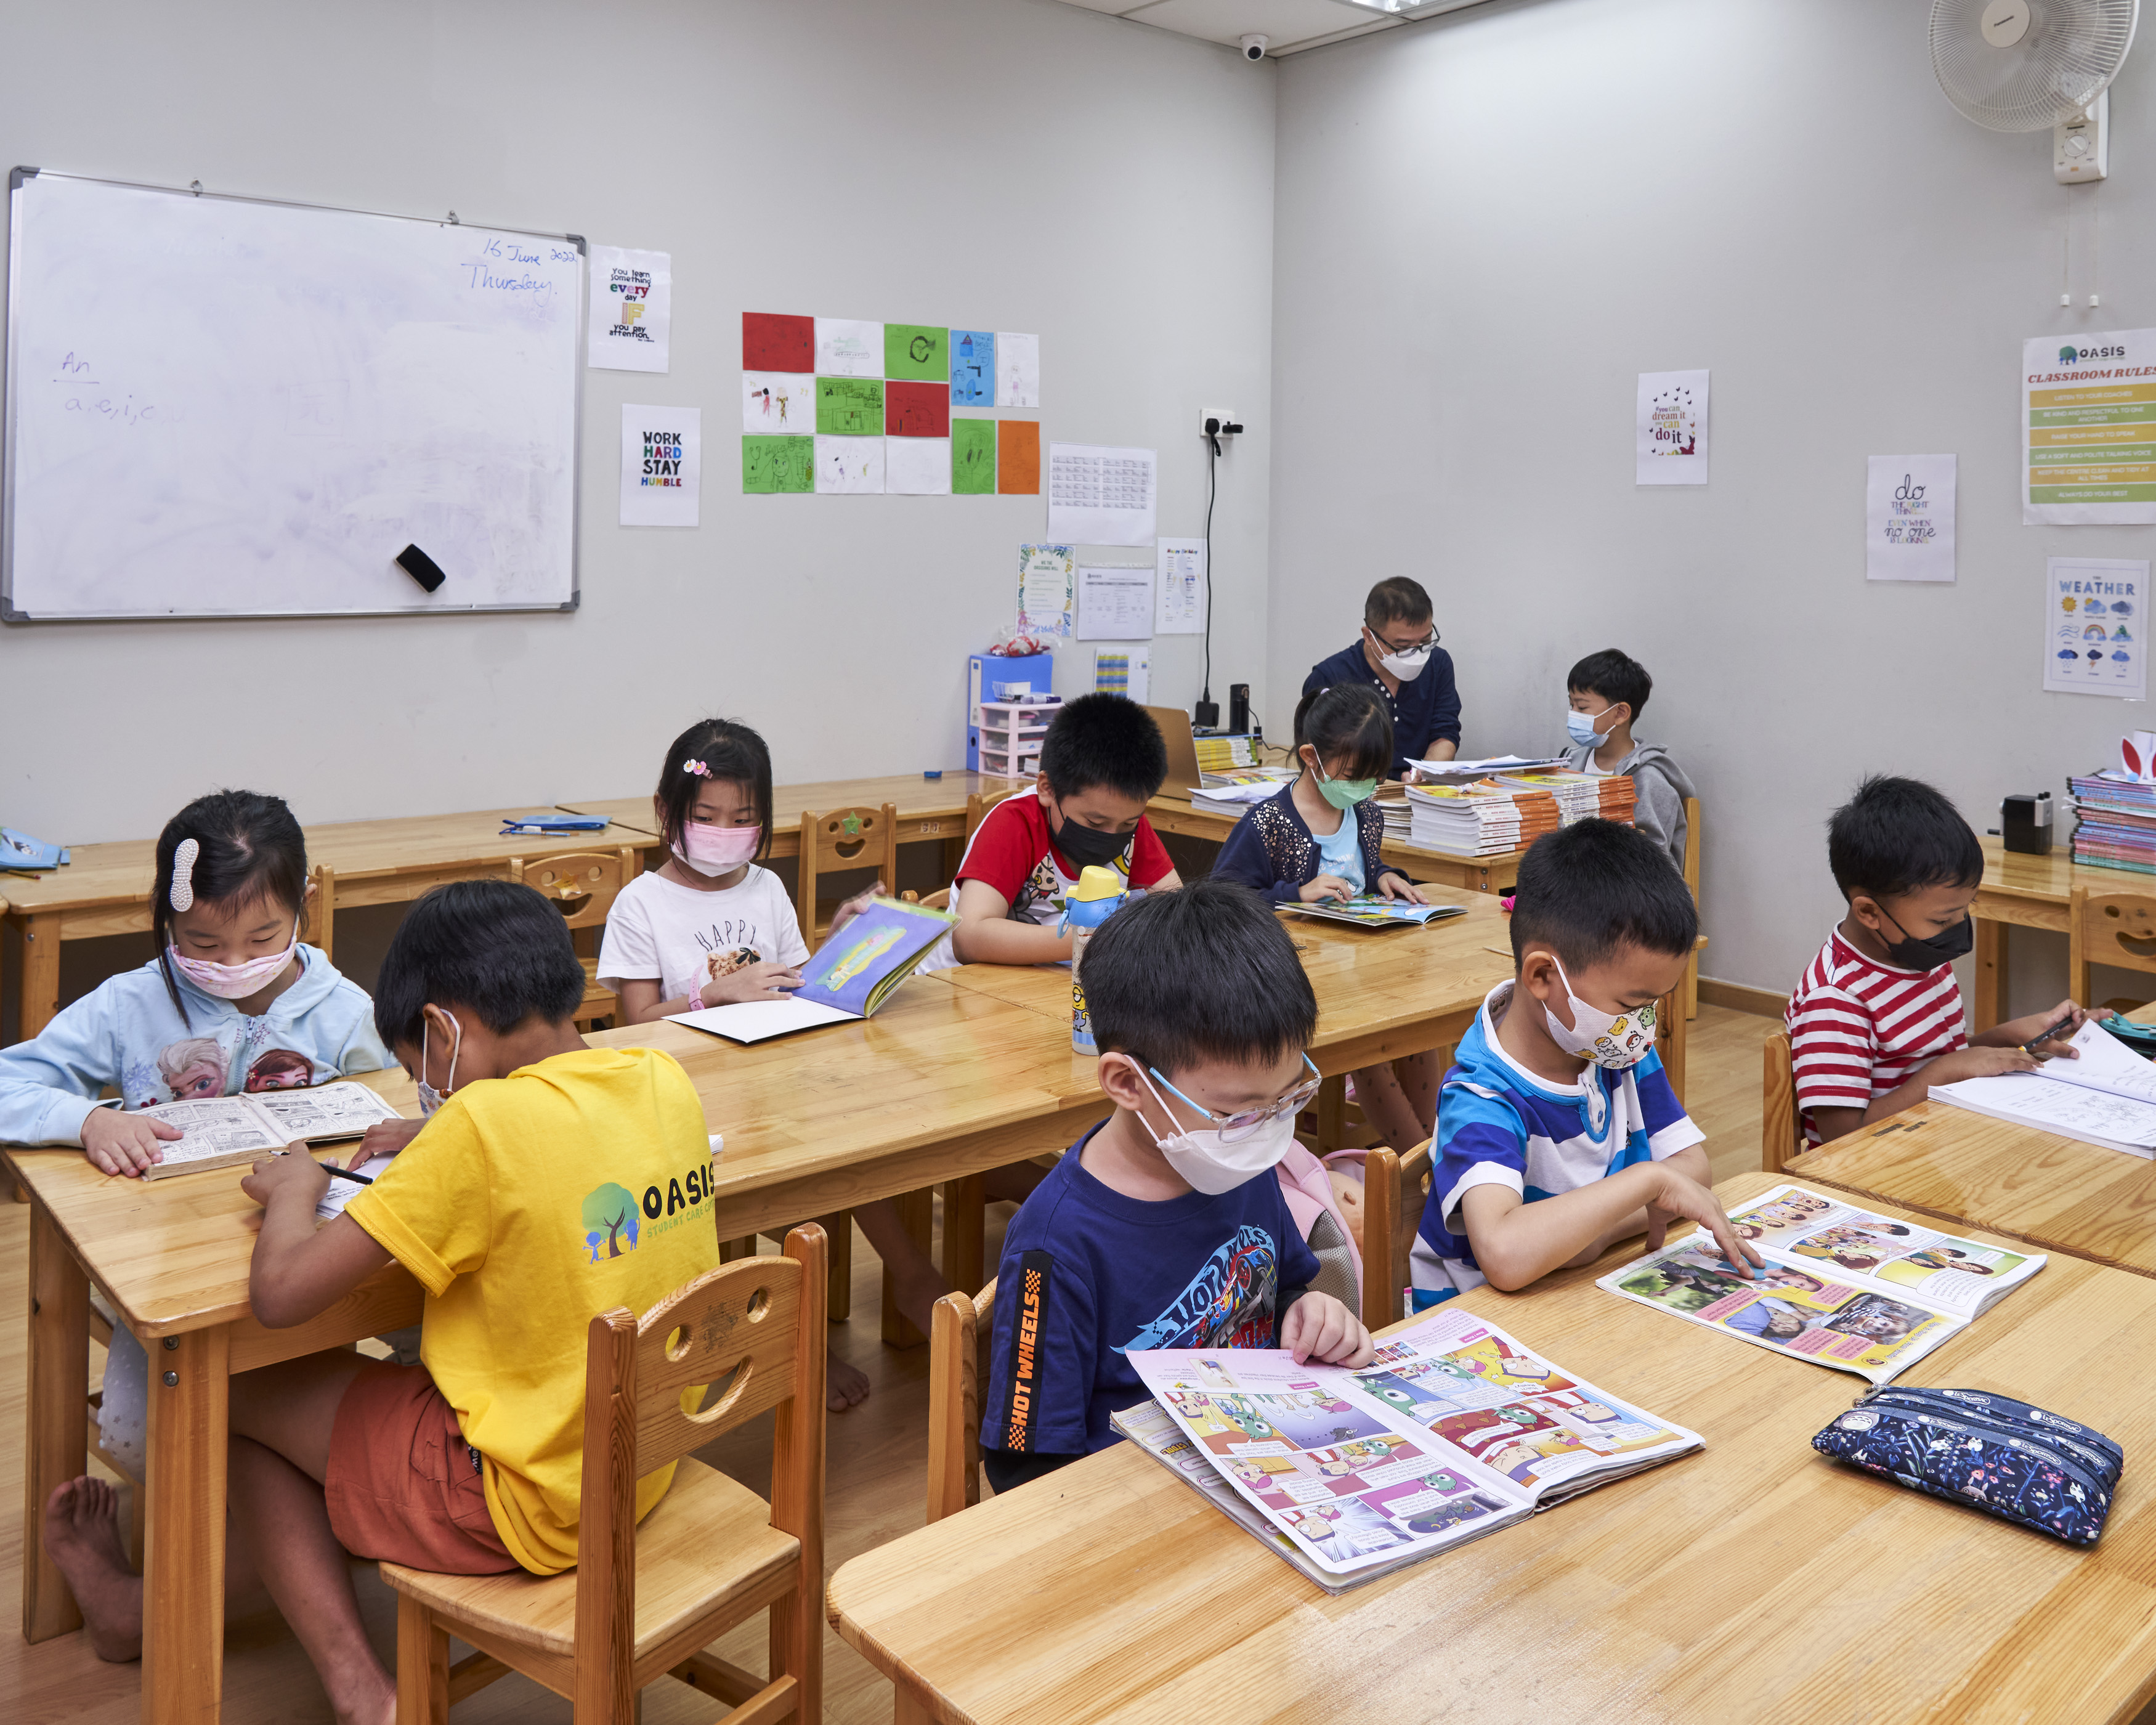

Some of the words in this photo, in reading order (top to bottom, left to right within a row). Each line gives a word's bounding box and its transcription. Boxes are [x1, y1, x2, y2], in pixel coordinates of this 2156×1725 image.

[484, 238, 501, 257] 16
[508, 245, 541, 266] June
[550, 248, 578, 262] 2022
[632, 270, 650, 278] learn
[610, 283, 649, 298] every
[622, 302, 645, 325] IF
[2080, 346, 2125, 358] OASIS
[2028, 370, 2112, 383] CLASSROOM
[2114, 367, 2156, 378] RULES
[1652, 412, 1677, 420] dream
[1663, 420, 1680, 428] can
[643, 431, 681, 445] WORK
[1656, 428, 1670, 440] do
[1672, 430, 1682, 444] it
[644, 445, 681, 458] HARD
[643, 459, 681, 475] STAY
[641, 477, 681, 487] HUMBLE
[1895, 474, 1926, 500] do
[1884, 528, 1903, 537] no
[1908, 527, 1936, 537] one
[2059, 580, 2135, 596] WEATHER
[694, 919, 756, 952] HAPPY
[642, 1161, 715, 1220] OASIS
[647, 1214, 683, 1238] STUDENT
[686, 1205, 703, 1222] CARE
[1017, 1291, 1040, 1381] WHEELS
[1011, 1381, 1031, 1427] HOT
